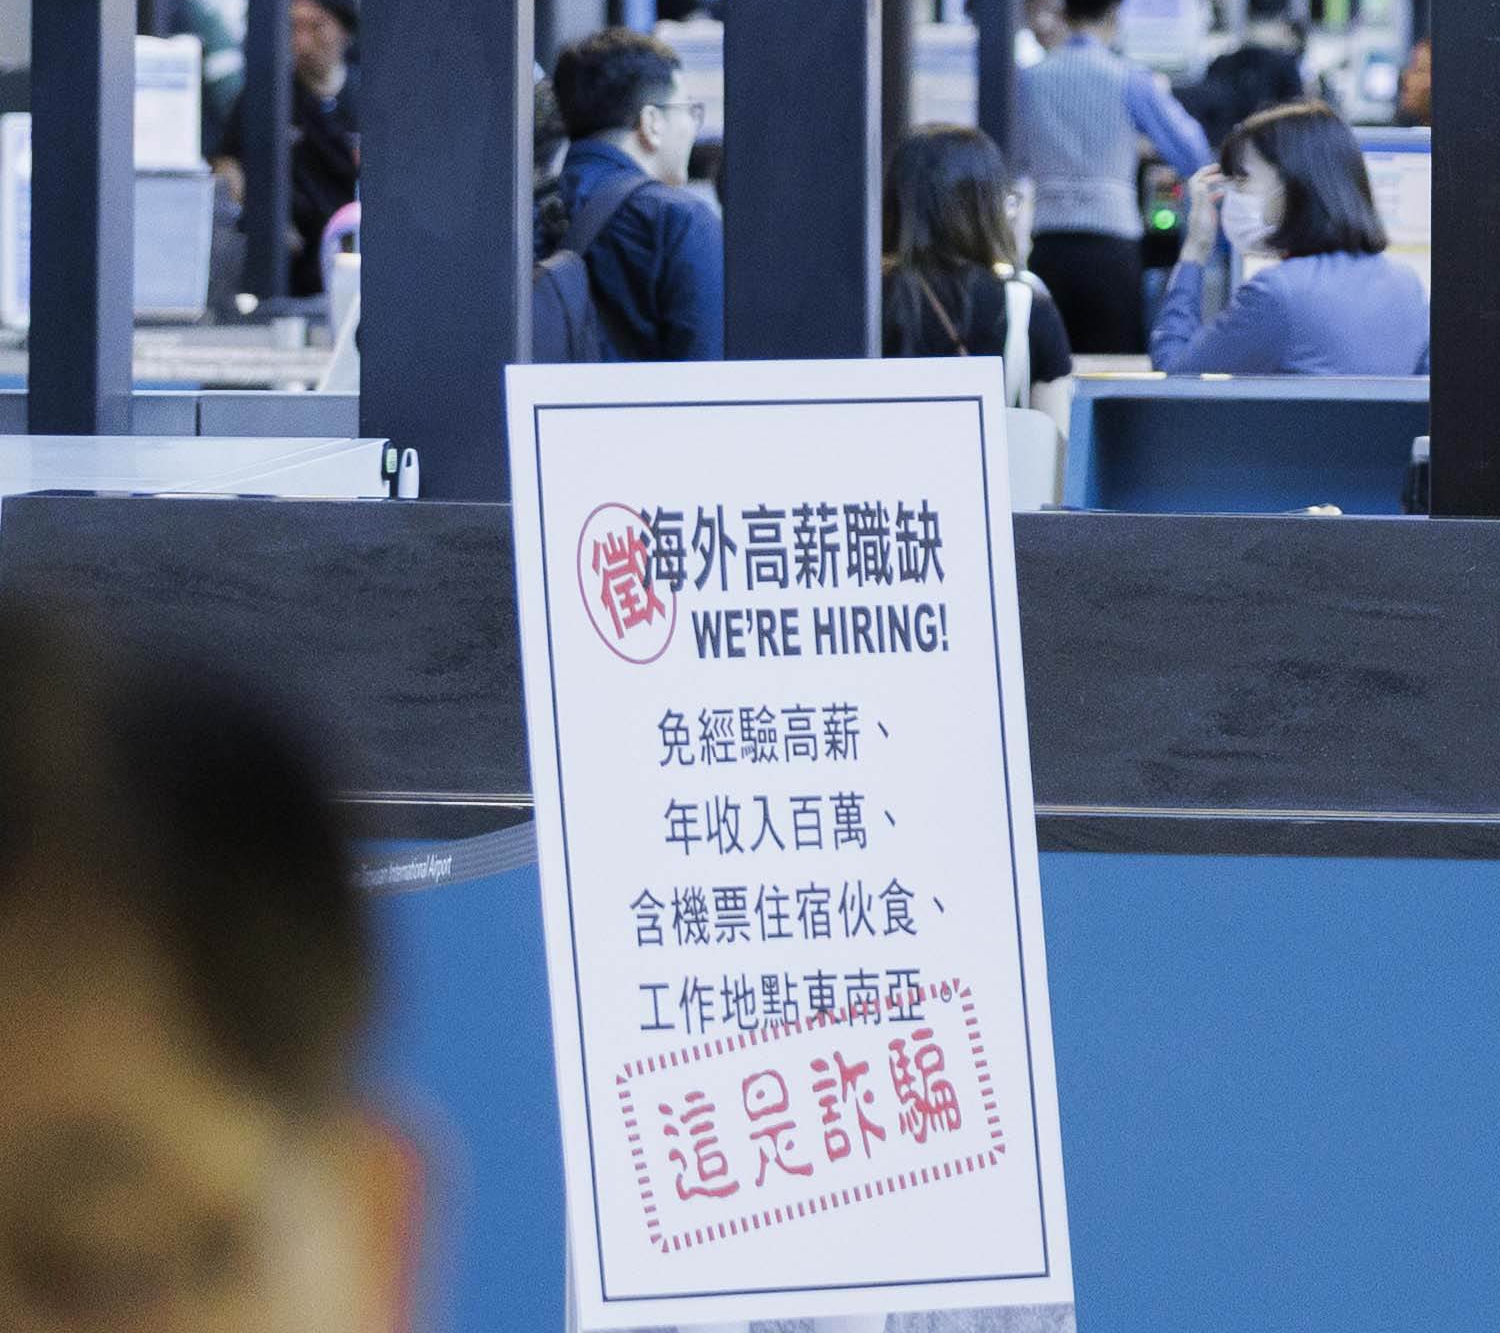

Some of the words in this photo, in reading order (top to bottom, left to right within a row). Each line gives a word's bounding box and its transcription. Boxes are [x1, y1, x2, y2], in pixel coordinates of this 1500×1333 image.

[639, 499, 945, 592] 海外高薪職缺
[813, 603, 949, 655] HIRING!
[657, 702, 889, 767] 免經驗高薪、
[664, 791, 896, 855] 年收入百萬、
[630, 877, 945, 947] 含機票住宿伙食、
[658, 1028, 962, 1200] 這是詐騙
